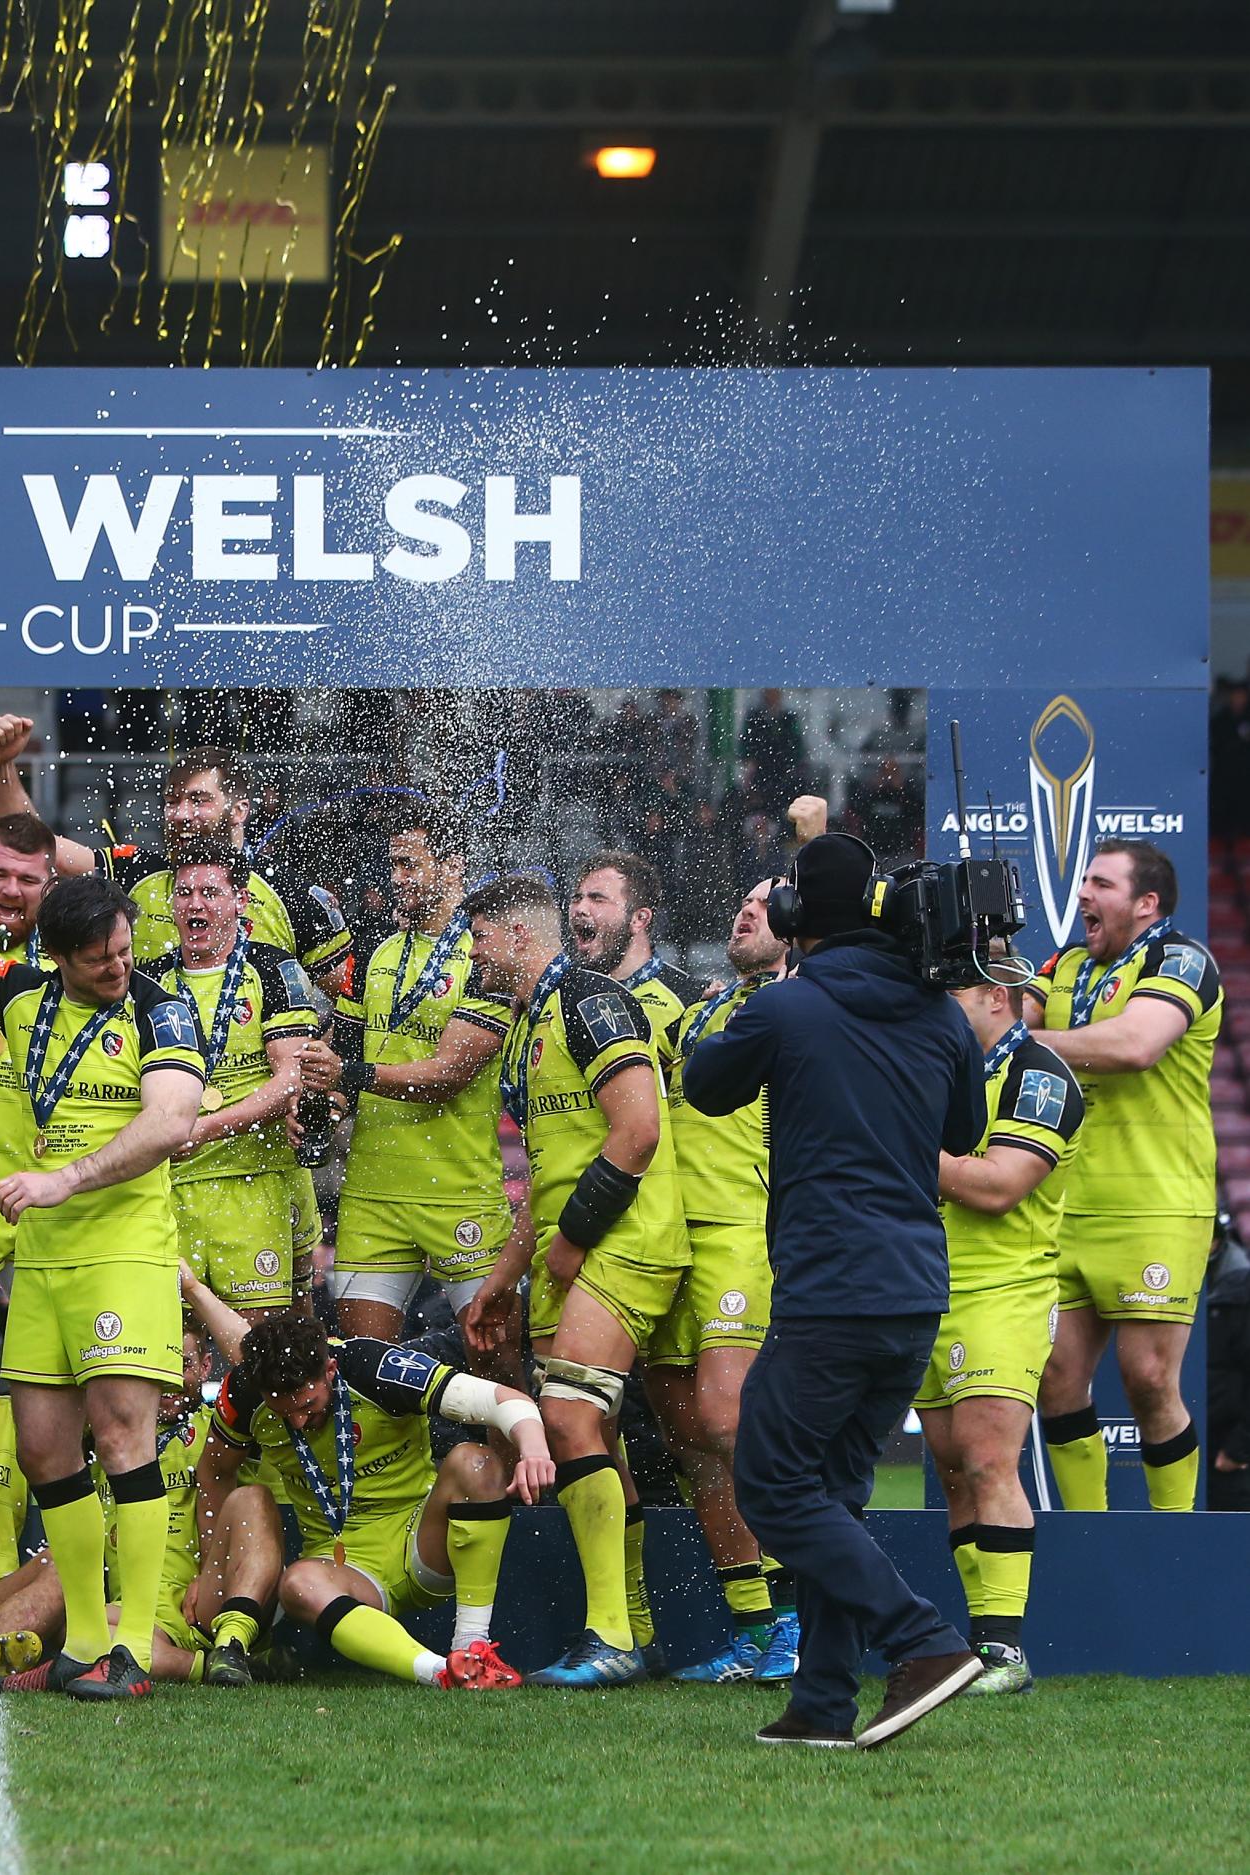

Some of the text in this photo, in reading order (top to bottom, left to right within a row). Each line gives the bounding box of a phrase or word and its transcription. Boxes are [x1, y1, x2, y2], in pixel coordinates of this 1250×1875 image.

[21, 473, 582, 582] WELSH
[20, 604, 161, 655] CUP
[1005, 803, 1026, 812] THE
[941, 813, 1183, 833] ANGLO WELSH
[80, 1081, 141, 1099] BARRE
[437, 1248, 487, 1267] LeoVegas
[231, 1280, 282, 1294] LeoVegas
[80, 1344, 147, 1362] LeoVegas SPORT
[966, 1368, 995, 1378] SPORT
